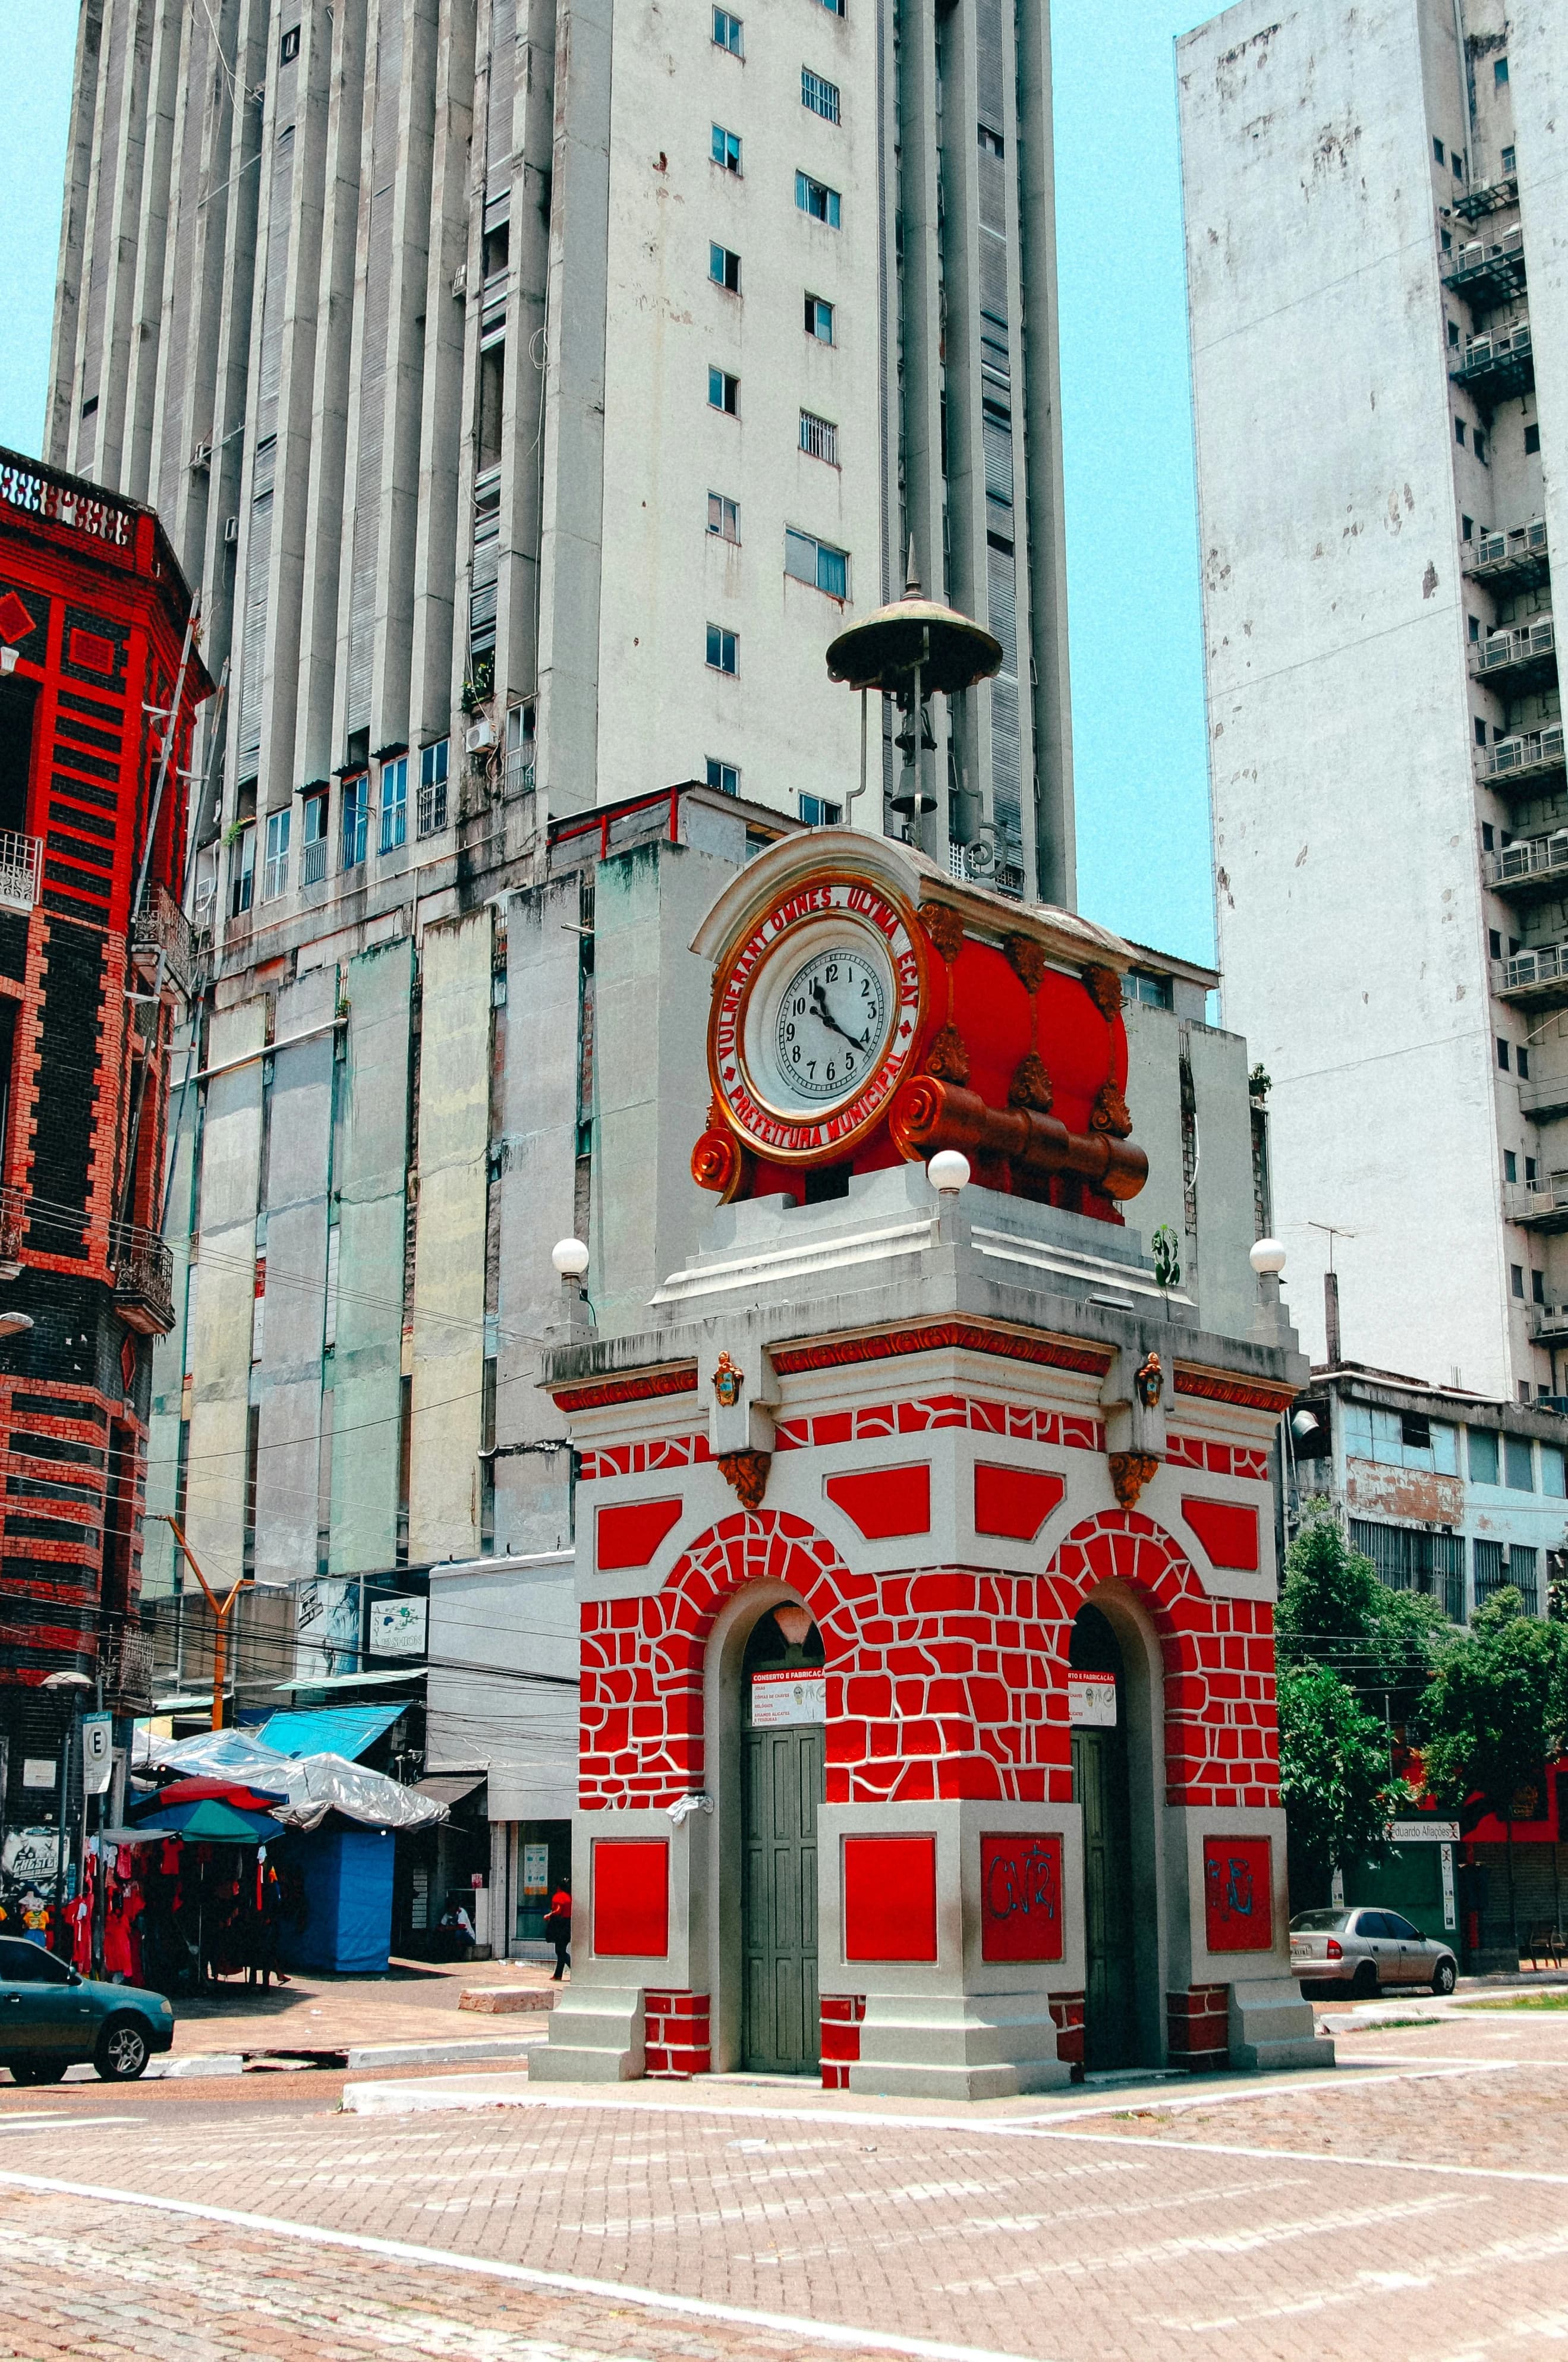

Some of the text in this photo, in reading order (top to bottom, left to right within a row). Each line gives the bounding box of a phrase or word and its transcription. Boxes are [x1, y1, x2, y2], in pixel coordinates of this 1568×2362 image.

[719, 927, 768, 1060] VULNERANT
[847, 887, 901, 939] ULTIMA
[826, 964, 838, 983] 12
[848, 966, 852, 982] 1
[861, 979, 870, 997] 2
[792, 997, 805, 1016] 10
[867, 1001, 877, 1019] 3
[786, 1023, 795, 1041] 9
[860, 1027, 870, 1043] 4
[792, 1045, 801, 1063] 8
[845, 1053, 854, 1070] 5
[807, 1060, 817, 1079] 7
[827, 1062, 835, 1080] 6
[729, 1050, 908, 1148] PREFEITURA MUNICIPAL
[381, 1634, 423, 1647] FASHION
[94, 1731, 101, 1753] E
[1422, 1826, 1449, 1840] Afiações
